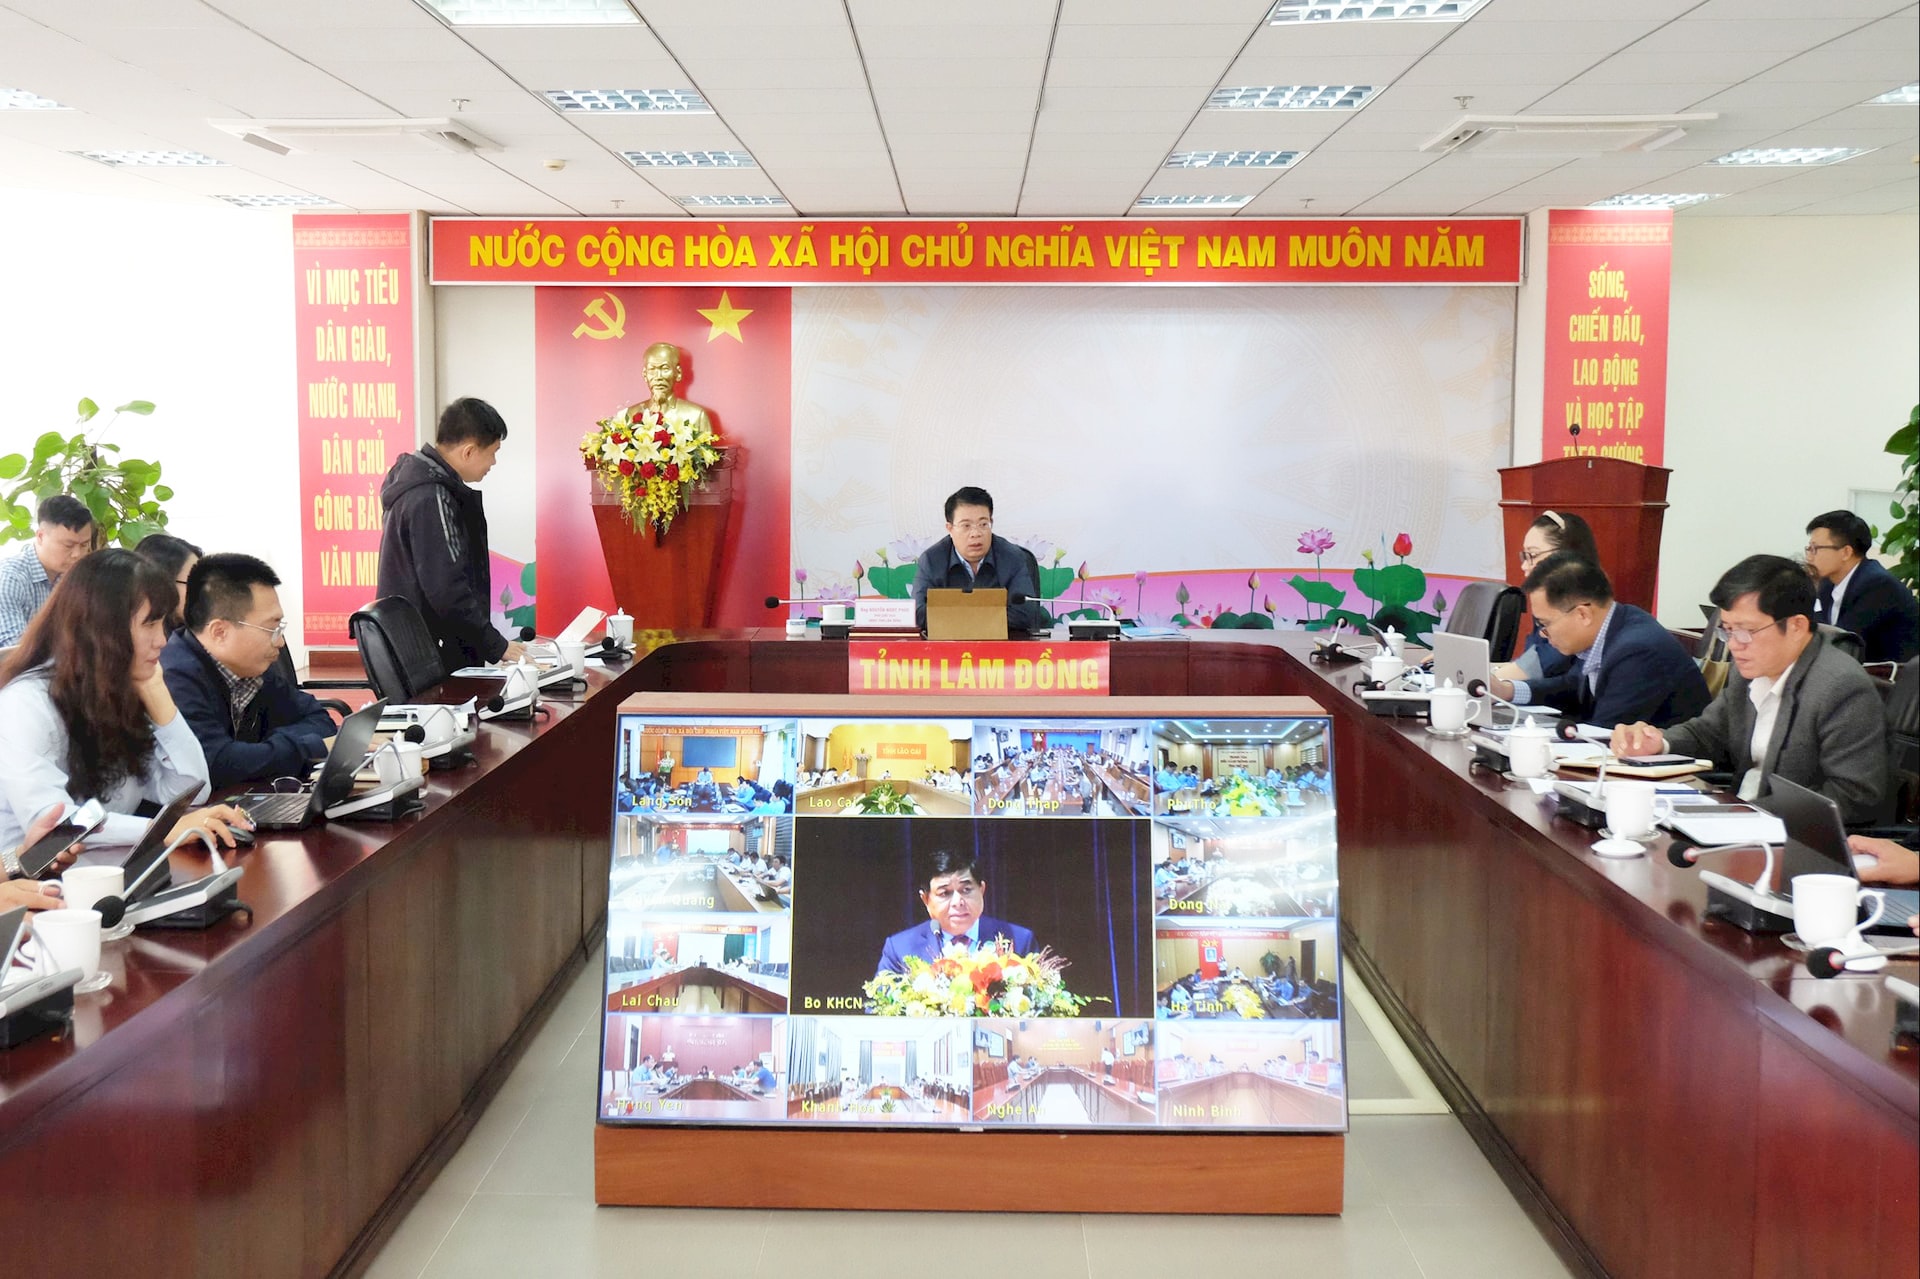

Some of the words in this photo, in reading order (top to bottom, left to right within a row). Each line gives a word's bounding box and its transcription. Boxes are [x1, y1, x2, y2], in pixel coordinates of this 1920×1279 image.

[469, 223, 565, 267] NƯỚC
[577, 227, 674, 276] CỘNG
[685, 224, 757, 267] HÒA
[768, 226, 817, 267] XÃ
[831, 227, 889, 276] HỘI
[901, 222, 974, 268] CHỦ
[986, 224, 1094, 267] NGHĨA
[1104, 227, 1184, 276] VIỆT
[1197, 234, 1276, 267] NAM
[1288, 226, 1391, 268] MUÔN
[1404, 226, 1485, 267] NĂM
[306, 261, 322, 305] VÌ
[326, 268, 360, 312] MỤC
[364, 261, 399, 305] TIÊU
[1588, 261, 1629, 302] SỐNG,
[316, 319, 347, 362] DÂN
[351, 319, 392, 367] GIÀU,
[1569, 306, 1609, 342] CHIẾN
[1613, 305, 1645, 346] ĐẤU,
[1573, 358, 1598, 386] LAO
[1602, 353, 1638, 392] ĐỘNG
[309, 375, 348, 419] NƯỚC
[352, 382, 401, 426] MẠNH,
[1565, 396, 1583, 429] VÀ
[1587, 402, 1613, 436] HỌC
[1618, 397, 1644, 436] TẬP
[322, 432, 353, 475] DÂN
[314, 487, 353, 531] CÔNG
[320, 544, 352, 587] VĂN
[859, 648, 931, 689] TỈNH
[940, 652, 1005, 689] LÂM
[1014, 647, 1099, 690] ĐỒNG
[632, 796, 662, 808] Lang
[669, 796, 692, 807] Son
[809, 796, 832, 807] Lao
[837, 796, 857, 807] Cai
[989, 798, 1021, 811] Dong
[1027, 798, 1059, 811] Thap
[1170, 899, 1203, 912] Dong
[622, 994, 641, 1006] Lai
[647, 994, 679, 1006] Chau
[805, 997, 821, 1009] Bo
[826, 997, 863, 1009] KHCN
[1172, 1001, 1188, 1012] Ha
[1195, 1000, 1223, 1012] Tinh
[659, 1100, 683, 1110] Yen
[987, 1104, 1022, 1118] Nghe
[1173, 1104, 1205, 1117] Ninh
[1211, 1104, 1241, 1117] Binh
